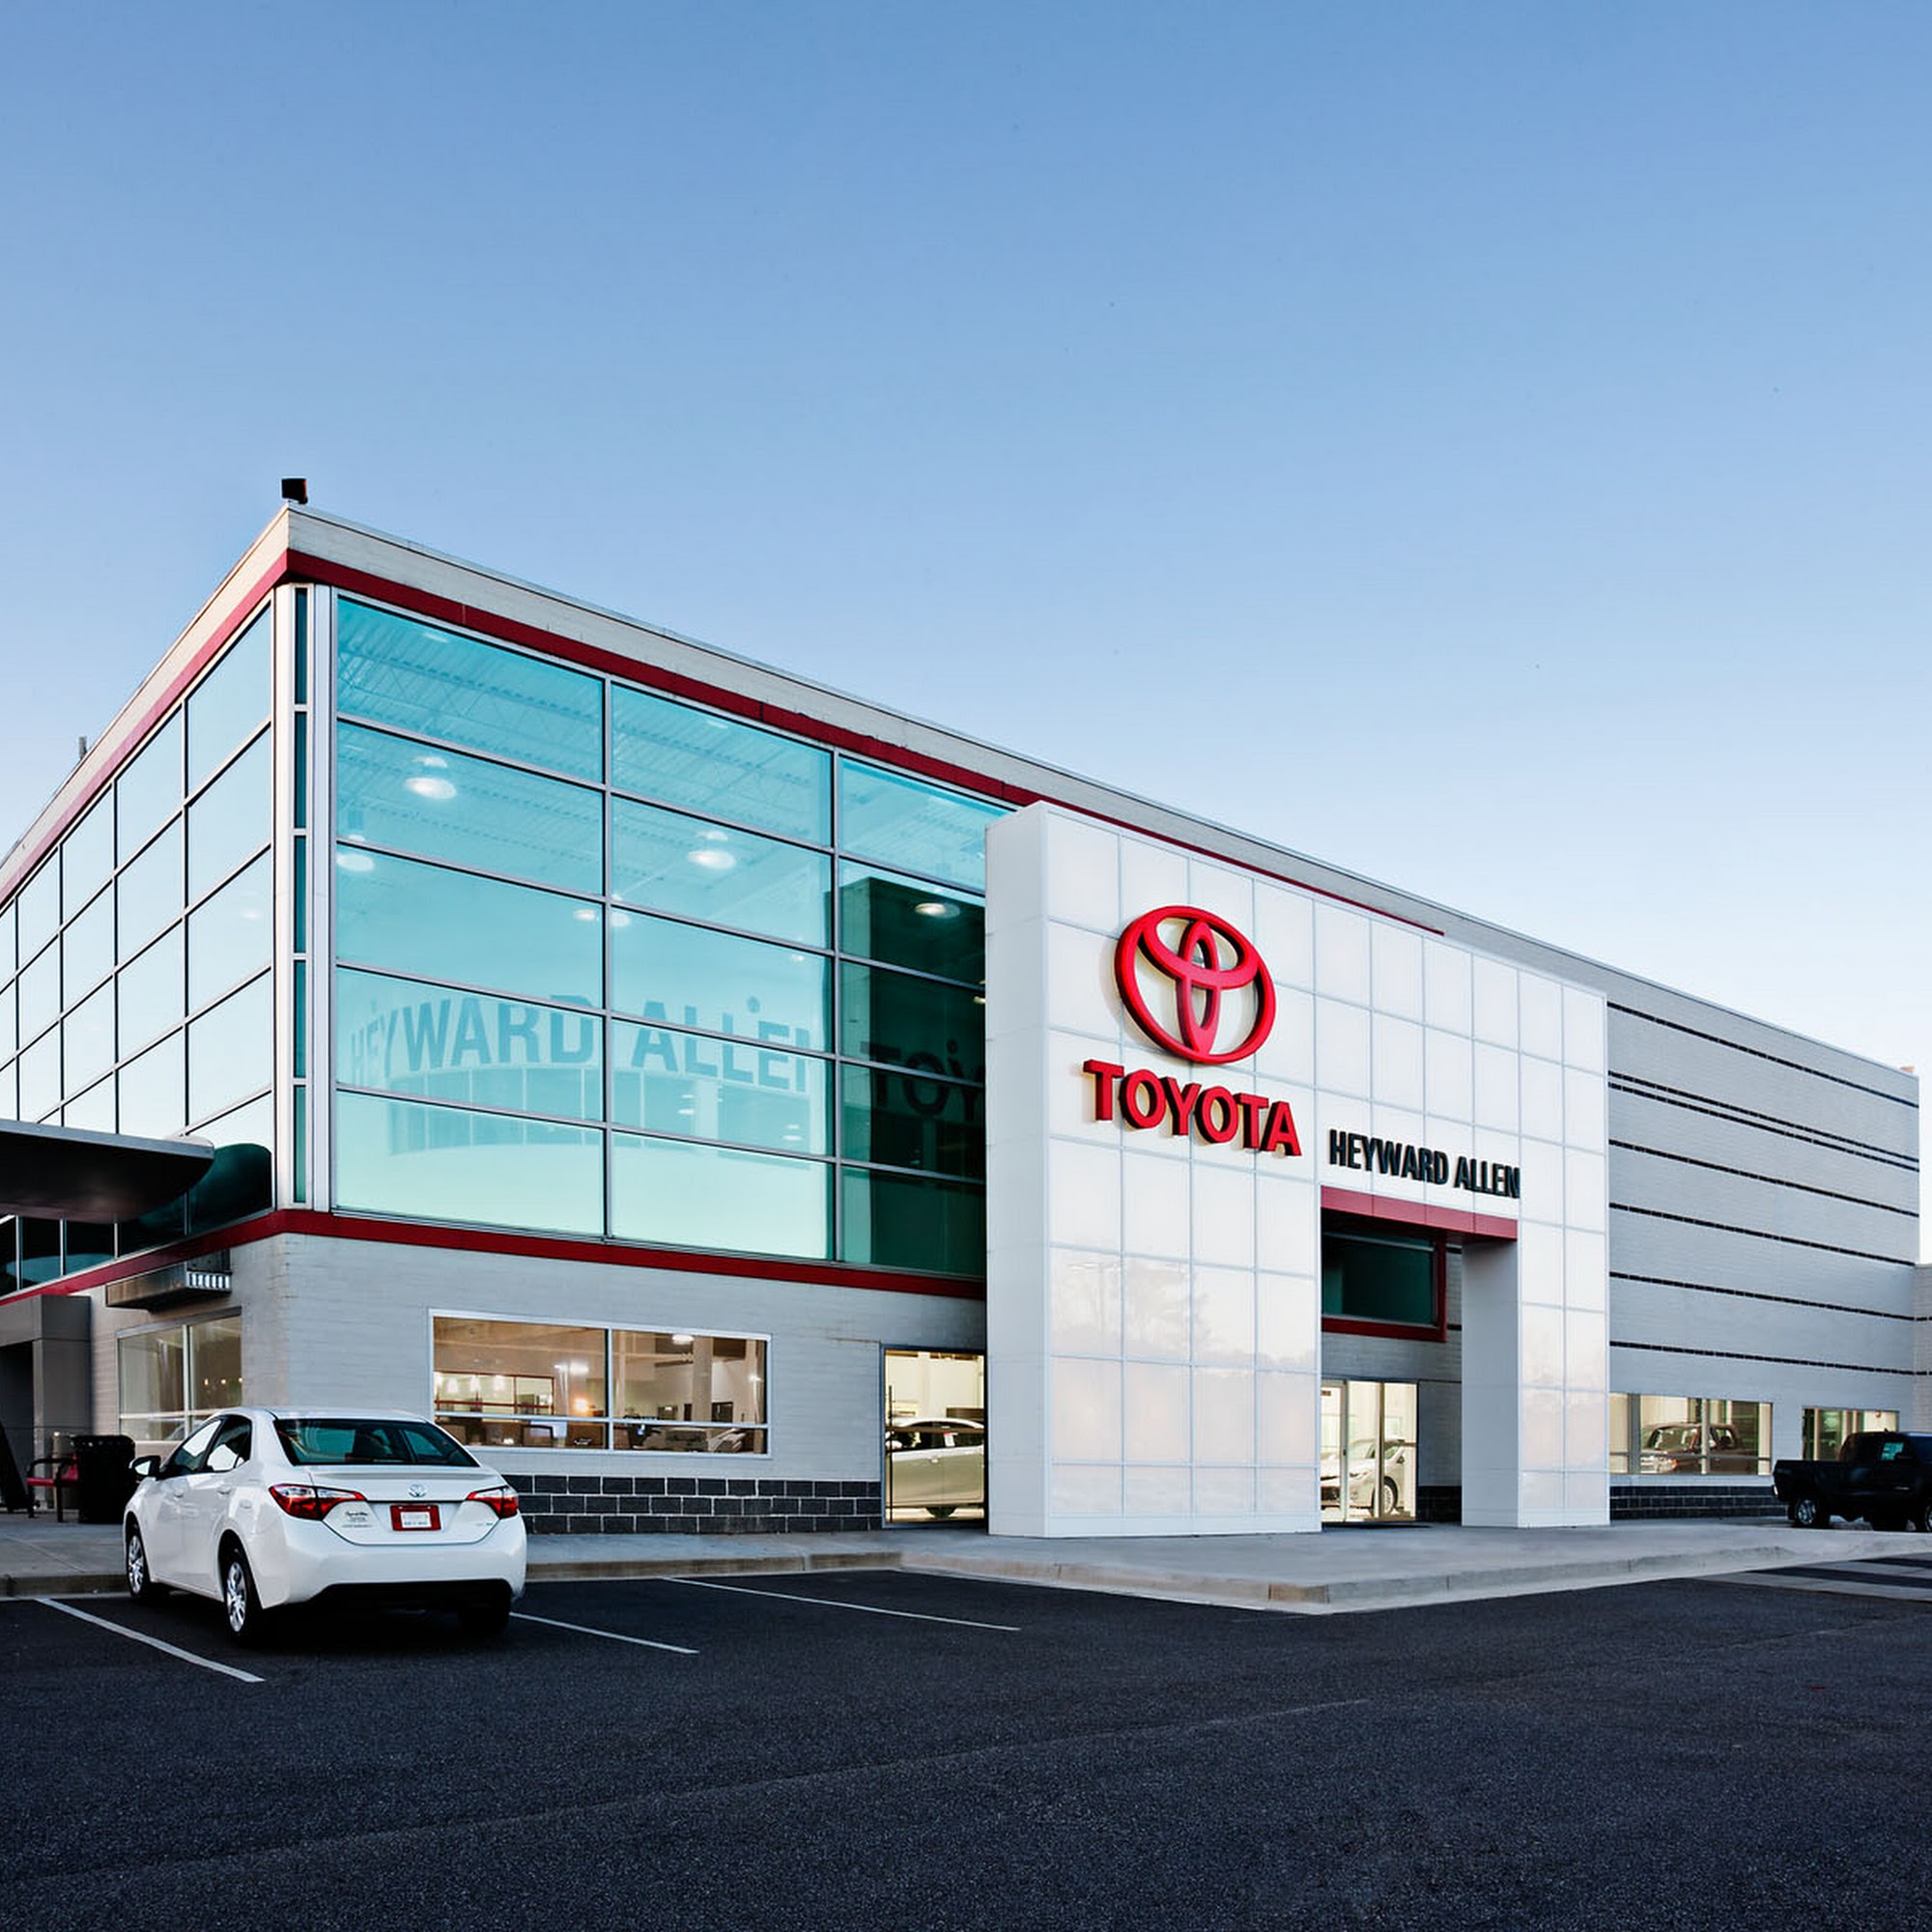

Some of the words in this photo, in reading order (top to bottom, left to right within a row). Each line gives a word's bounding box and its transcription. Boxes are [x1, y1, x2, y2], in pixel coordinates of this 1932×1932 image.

[351, 995, 595, 1084] HEYWARD
[1083, 1059, 1302, 1156] TOYOTA
[1329, 1128, 1449, 1185] HEYWARD
[1453, 1155, 1520, 1199] ALLEN
